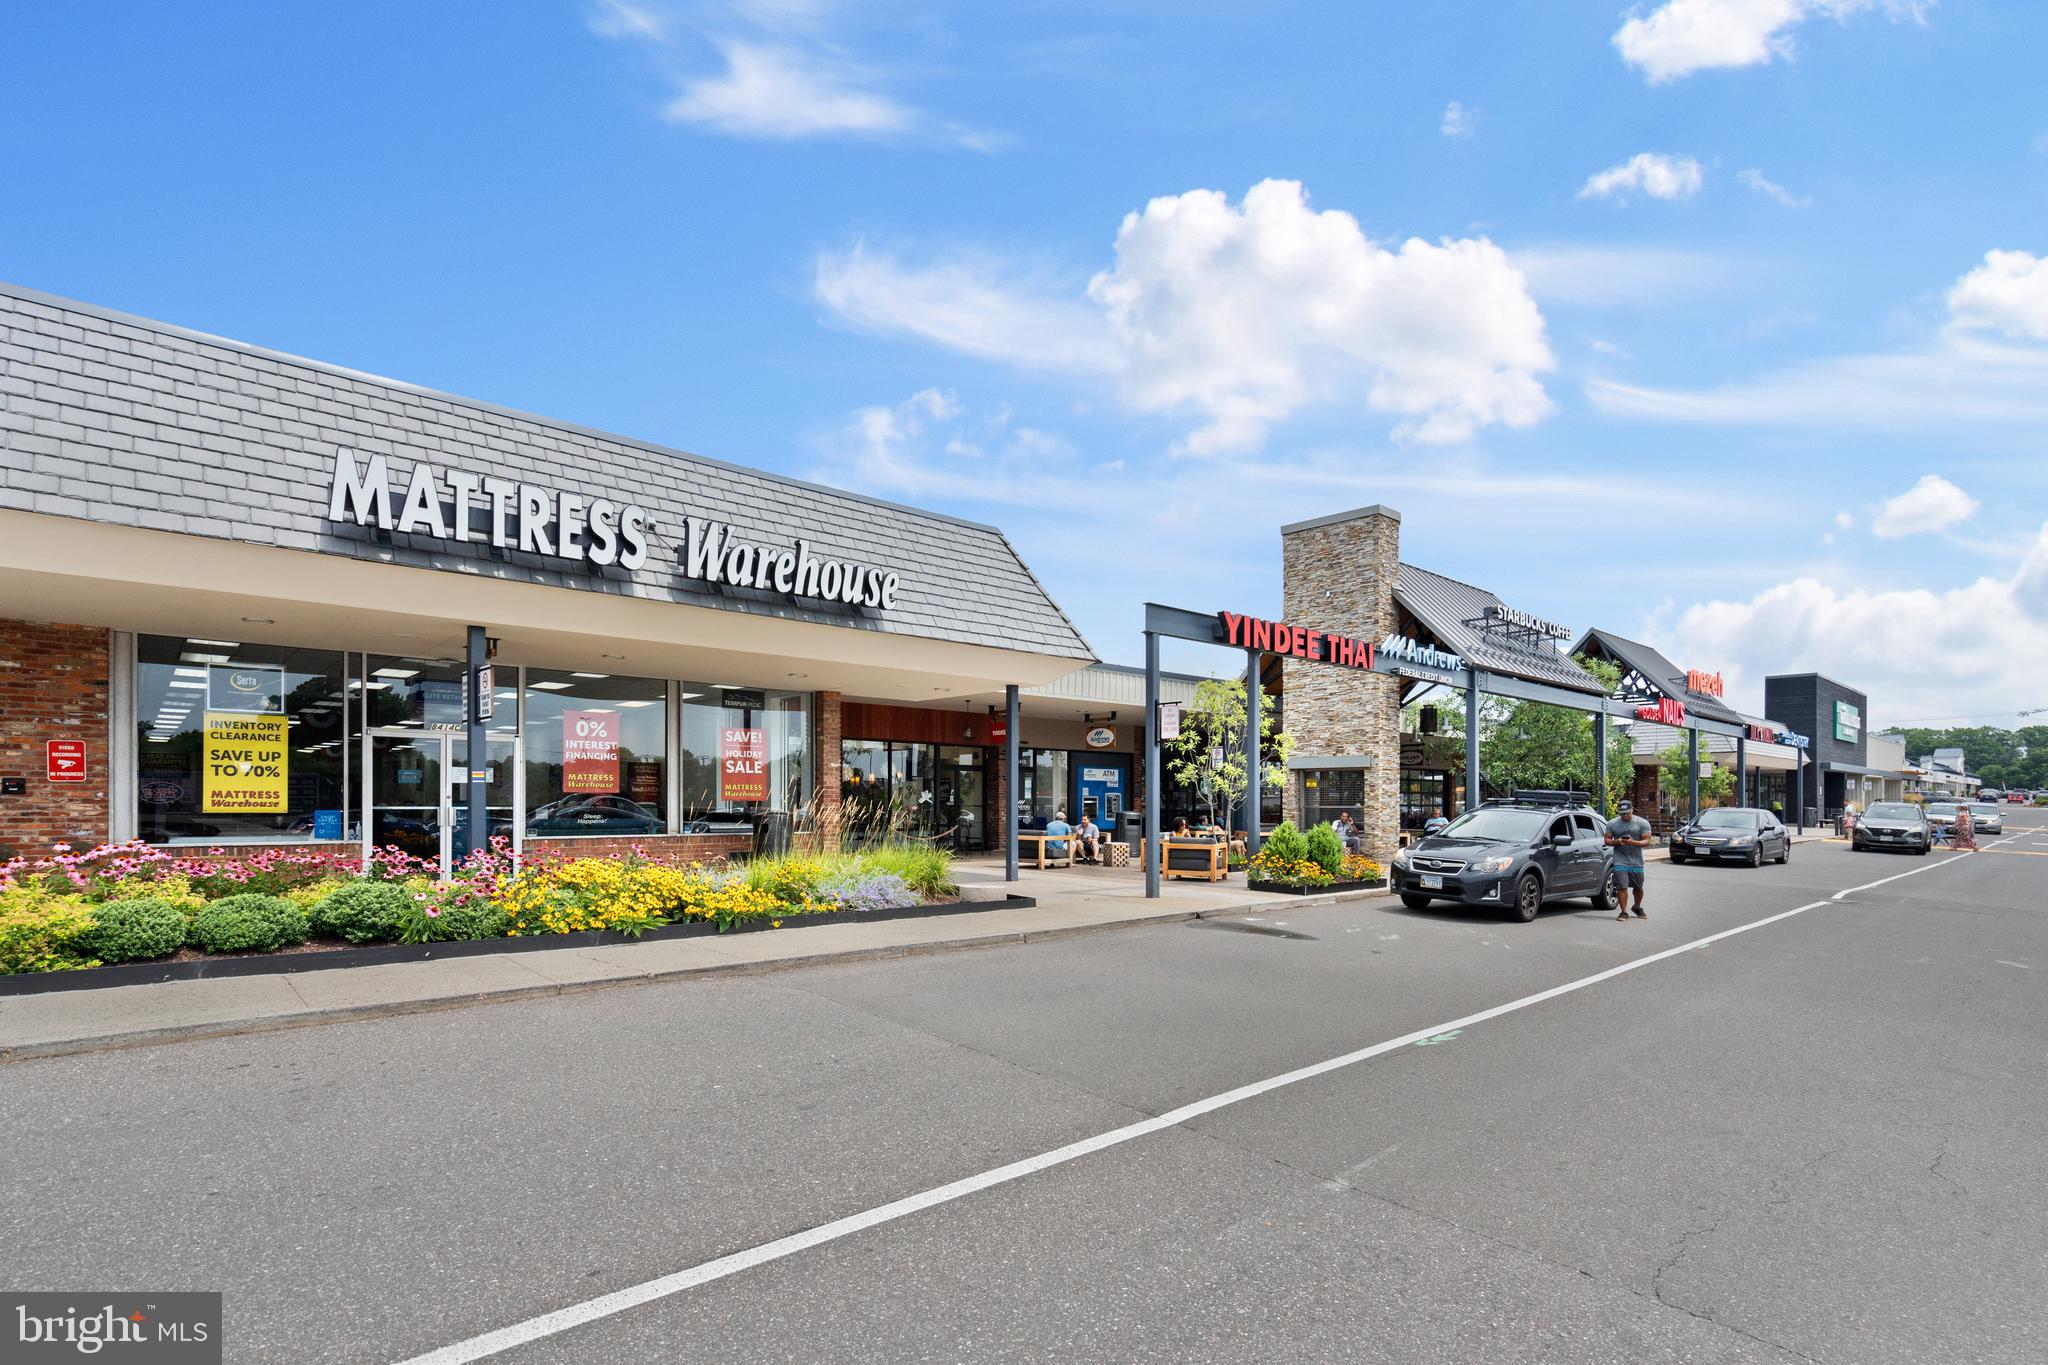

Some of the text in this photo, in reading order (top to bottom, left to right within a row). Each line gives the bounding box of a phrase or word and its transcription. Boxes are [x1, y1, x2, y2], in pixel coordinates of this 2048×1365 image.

[328, 446, 900, 609] MATTRESS Warehouse
[1497, 605, 1546, 632] STARBUCKS
[1220, 611, 1374, 670] YINDEE THAI
[1406, 638, 1461, 671] Andrews
[236, 674, 257, 686] Serta
[1400, 667, 1452, 684] FEDERAL CREDIT UNION
[1687, 669, 1724, 697] mezeh
[1663, 698, 1685, 726] NAILS
[210, 720, 282, 731] INVENTORY
[431, 723, 461, 731] 8414C
[576, 720, 608, 738] 0%
[210, 732, 281, 742] CLEARANCE
[725, 731, 762, 743] SAVE!
[565, 739, 617, 750] INTEREST
[210, 749, 281, 762] SAVE UP
[565, 751, 617, 761] FINANCING
[725, 749, 763, 758] HOLIDAY
[210, 764, 280, 778] TO 70%
[725, 760, 763, 774] SALE
[210, 790, 280, 799] MATTRESS
[210, 799, 280, 808] Warehouse
